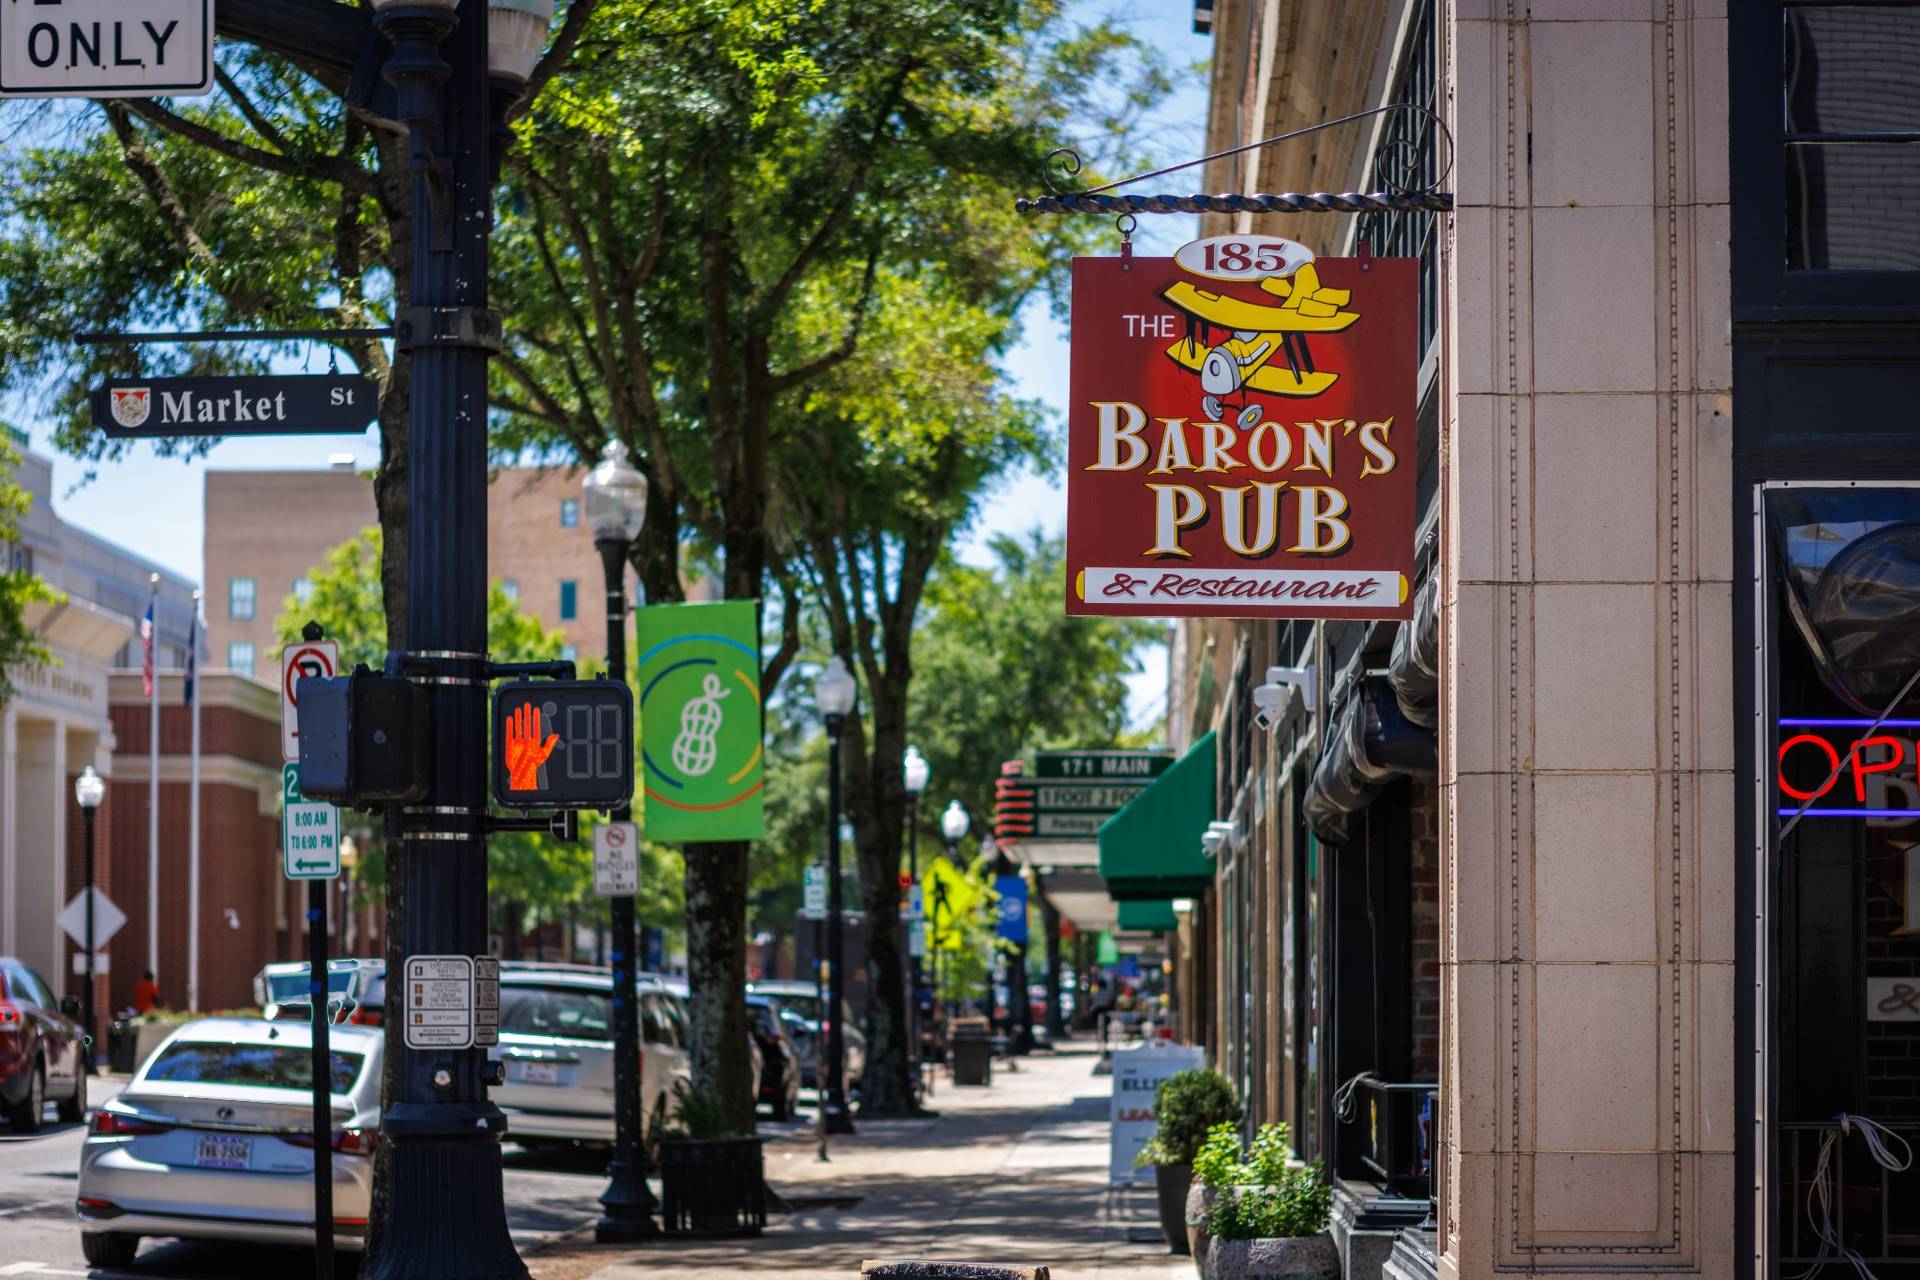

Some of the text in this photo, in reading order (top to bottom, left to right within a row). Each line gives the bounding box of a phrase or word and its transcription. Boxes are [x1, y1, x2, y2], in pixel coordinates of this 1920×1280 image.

[28, 21, 179, 68] ONLY
[1203, 242, 1288, 272] 185
[1121, 314, 1176, 338] THE
[160, 389, 287, 423] Market
[330, 387, 355, 406] St
[1083, 401, 1398, 479] BARON'S
[1141, 479, 1353, 558] PUB
[1102, 572, 1382, 599] & Restaurant
[1061, 757, 1151, 775] 171 MAIN
[1778, 732, 1920, 803] OP
[295, 811, 328, 827] 8:00 AM
[291, 834, 333, 850] TO 6:00 PM
